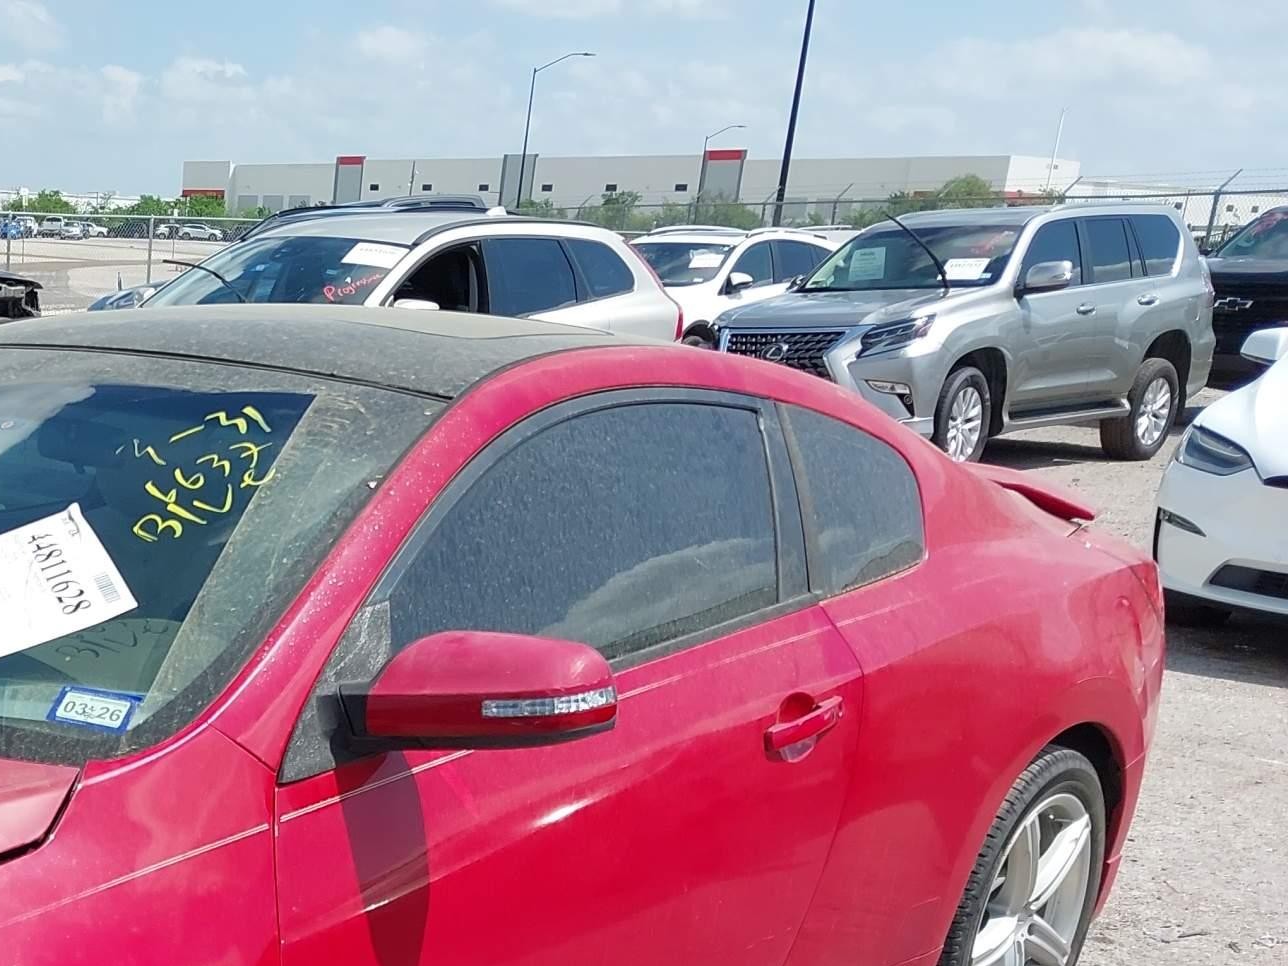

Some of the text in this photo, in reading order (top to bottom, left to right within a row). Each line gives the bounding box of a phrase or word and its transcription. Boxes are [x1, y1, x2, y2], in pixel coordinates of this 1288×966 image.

[27, 533, 92, 615] 44811628
[63, 700, 123, 722] 03 26
